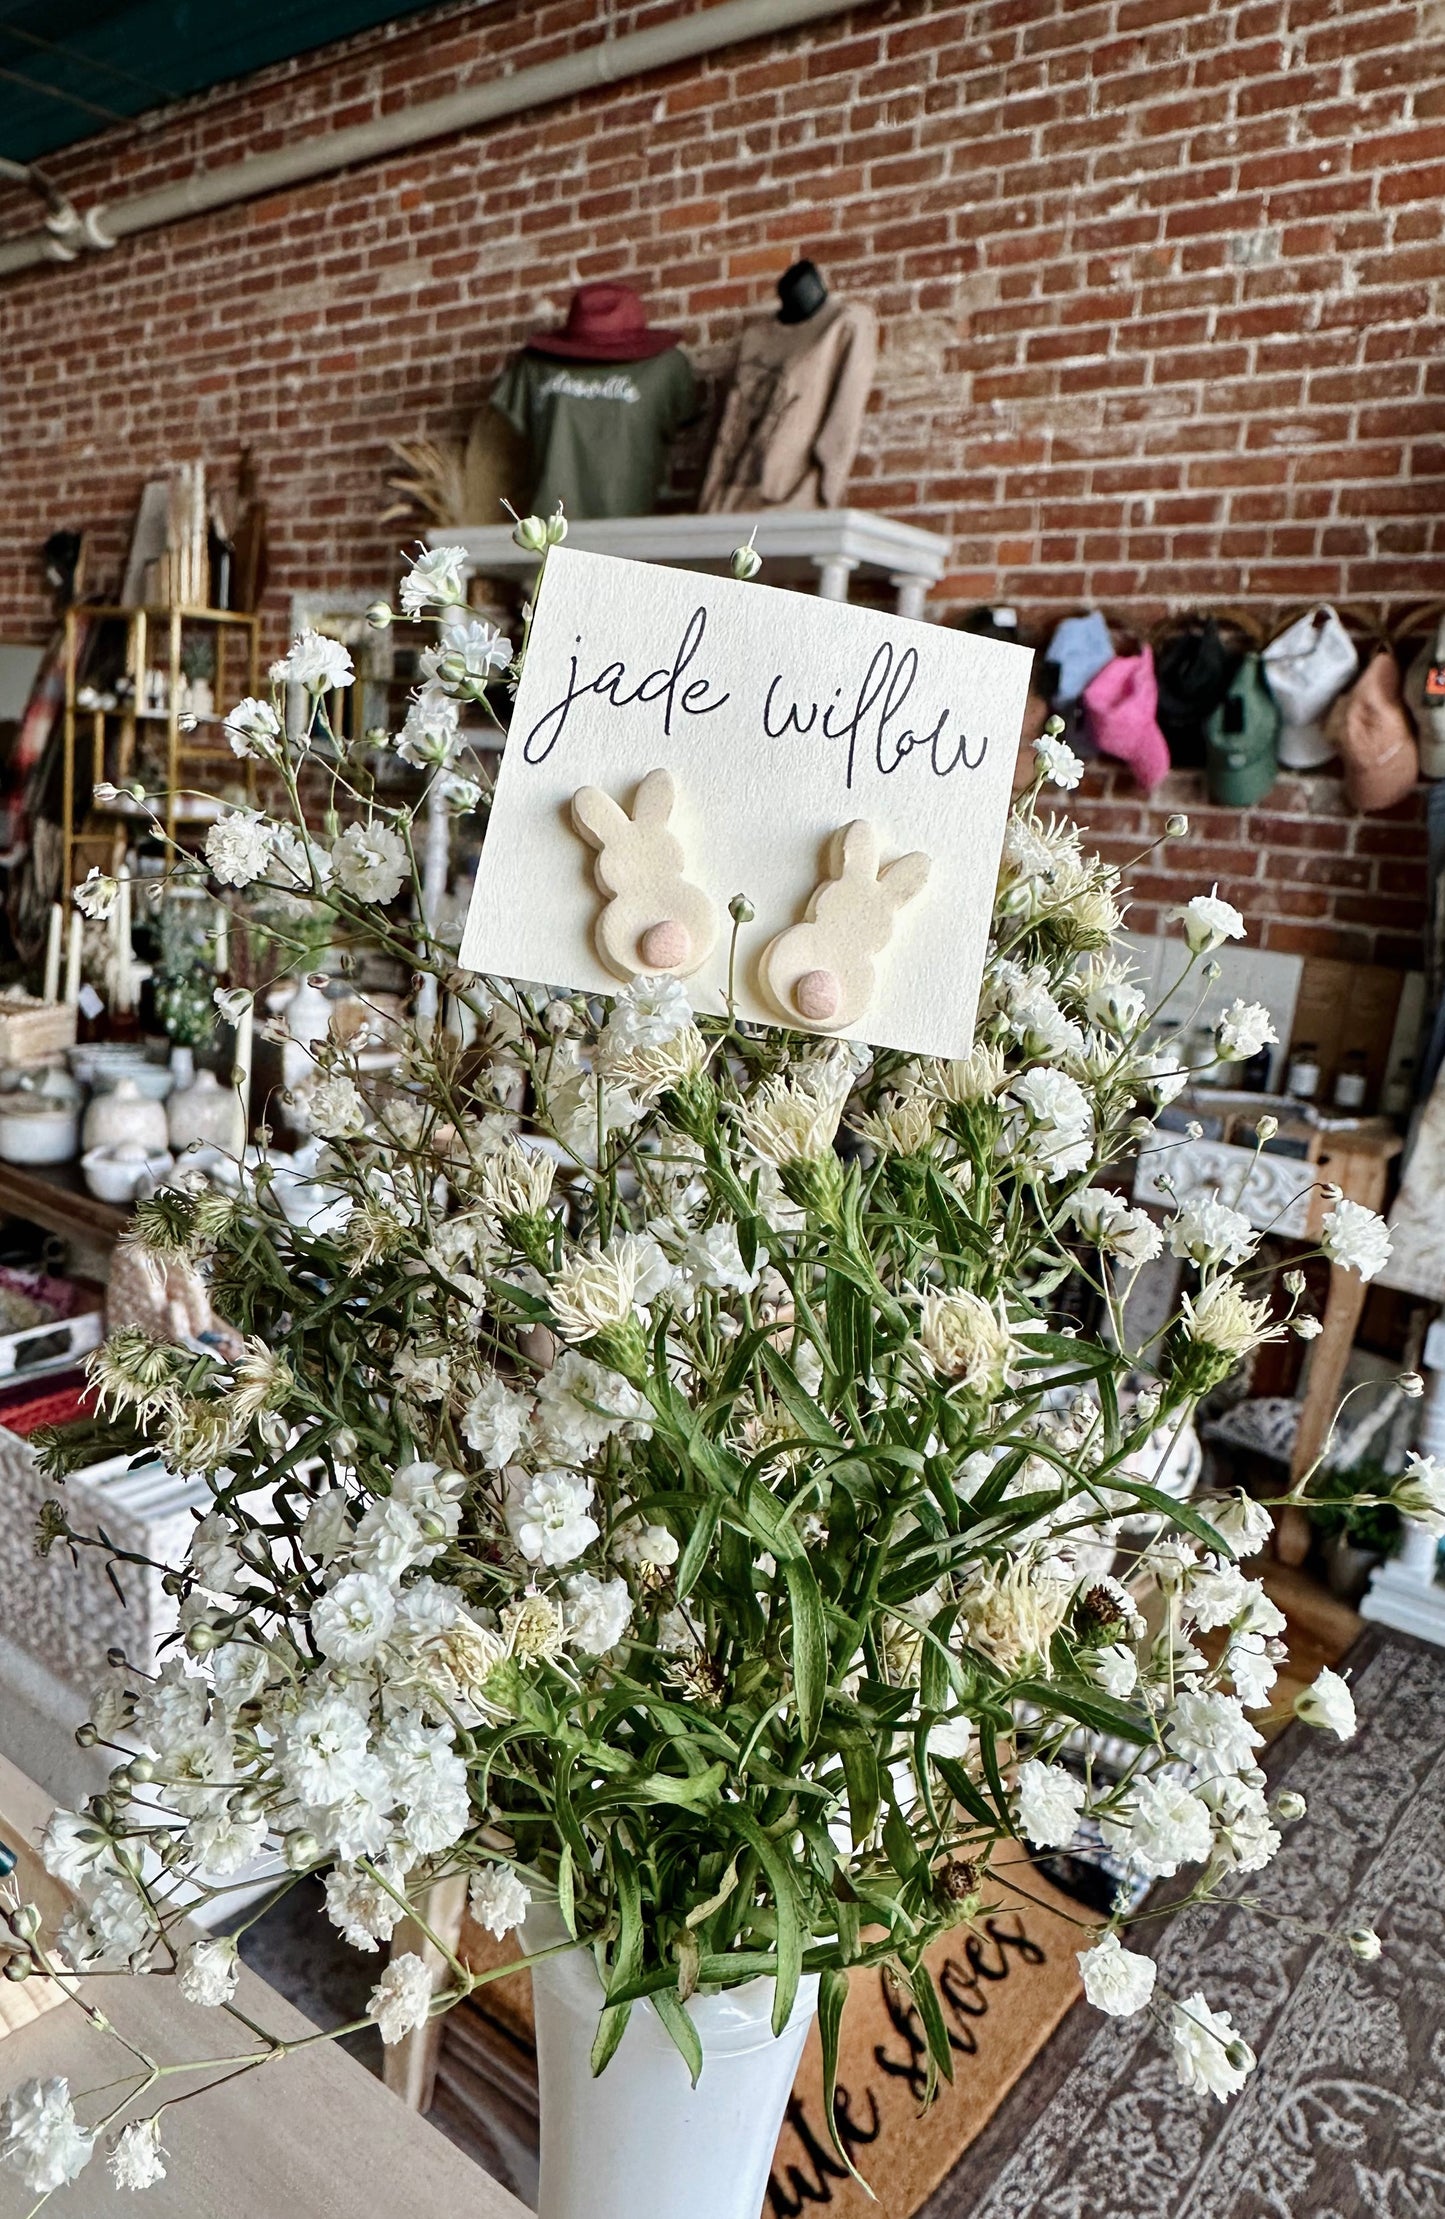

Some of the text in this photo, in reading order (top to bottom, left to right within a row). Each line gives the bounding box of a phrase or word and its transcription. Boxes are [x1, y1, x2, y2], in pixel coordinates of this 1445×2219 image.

[523, 606, 989, 789] jade willow
[764, 2084, 880, 2219] ute
